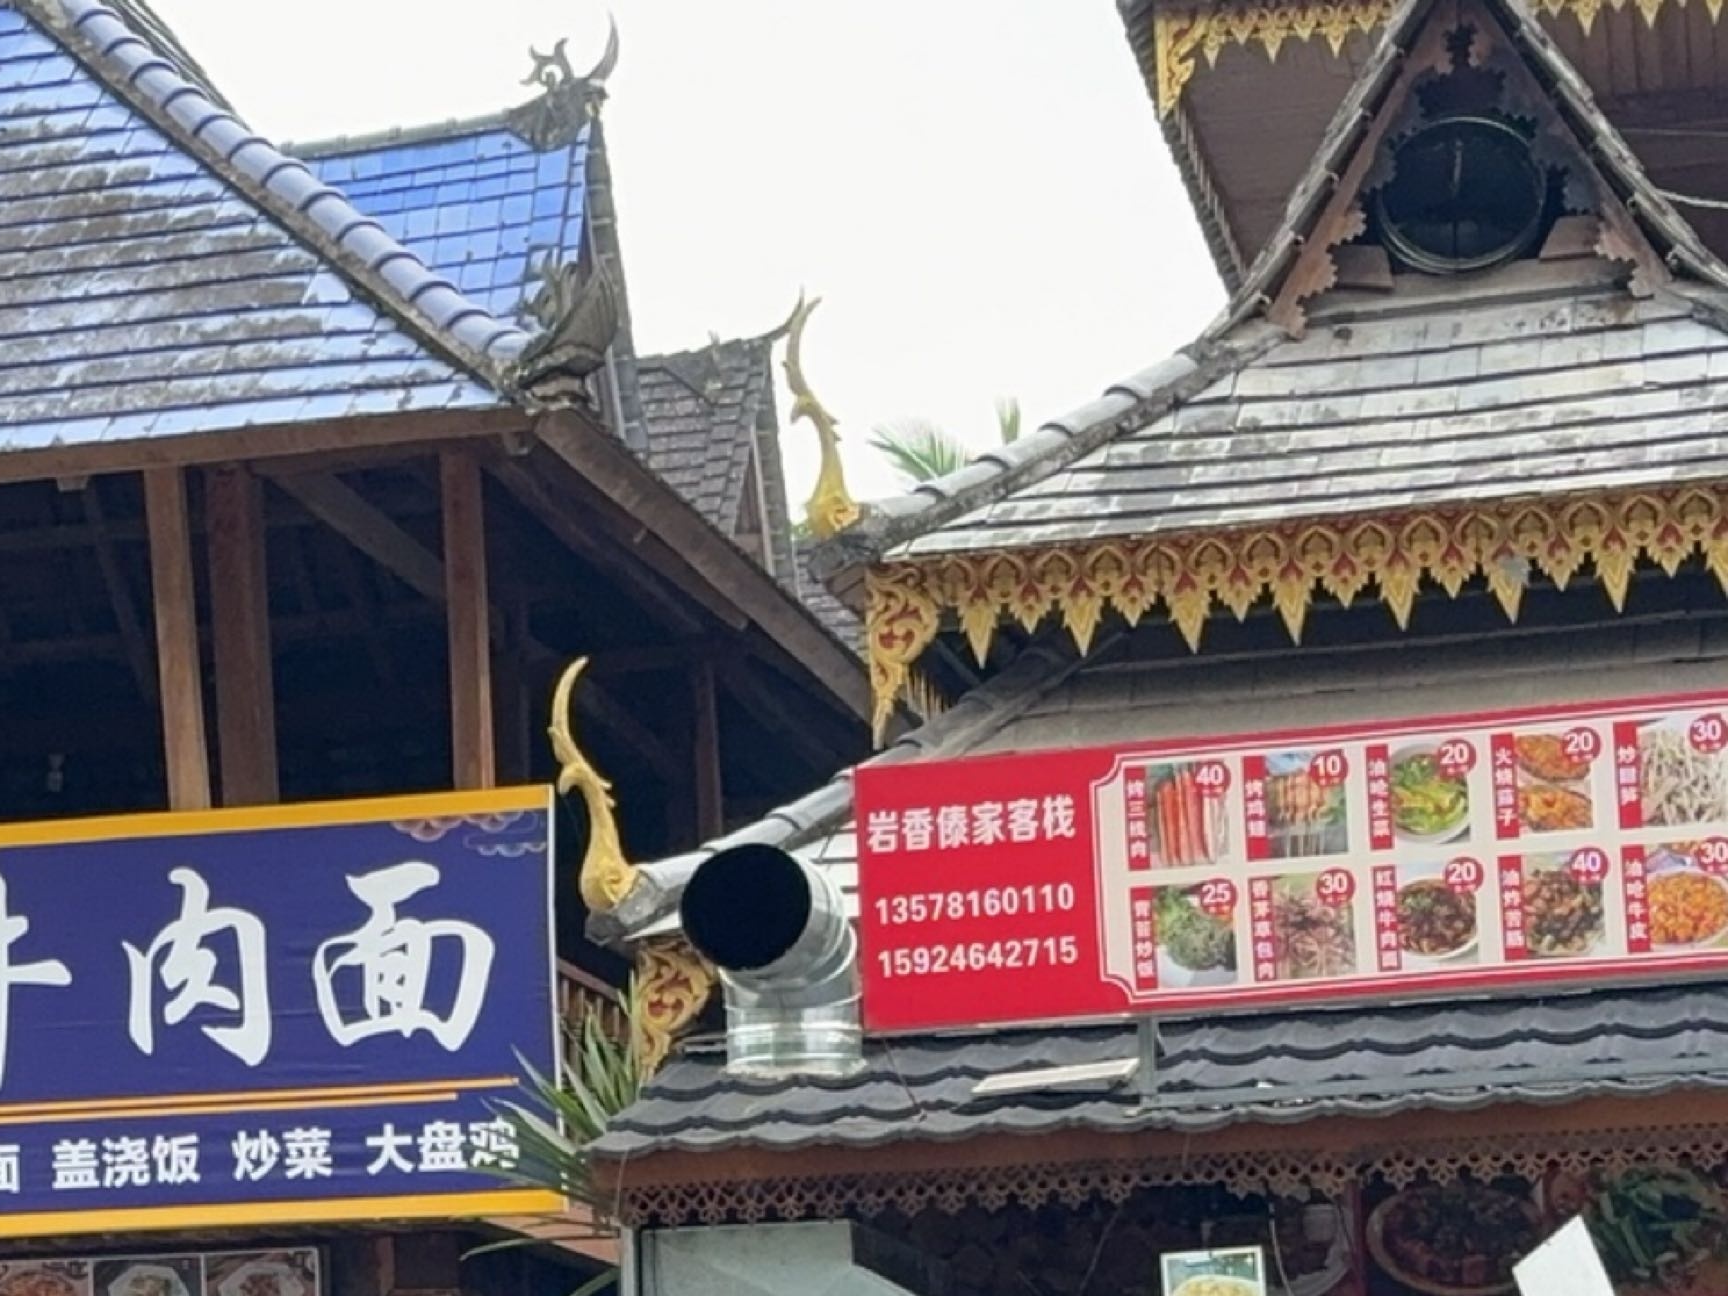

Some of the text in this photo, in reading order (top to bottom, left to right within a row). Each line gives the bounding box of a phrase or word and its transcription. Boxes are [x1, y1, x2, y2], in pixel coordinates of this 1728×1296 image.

[1693, 720, 1722, 742] 30
[1565, 732, 1593, 754] 20
[1314, 755, 1341, 775] 10
[1440, 744, 1468, 765] 20
[1196, 765, 1223, 785] 40
[867, 793, 1076, 852] 岩香傣家客栈
[1575, 852, 1602, 872] 40
[1700, 842, 1728, 864] 30
[1448, 863, 1476, 882] 20
[1201, 883, 1231, 904] 25
[1320, 873, 1347, 894] 30
[875, 882, 1075, 925] 13578160110
[878, 935, 1079, 978] 15924642715
[52, 1133, 201, 1189] 盖浇饭
[232, 1126, 334, 1181] 炒菜
